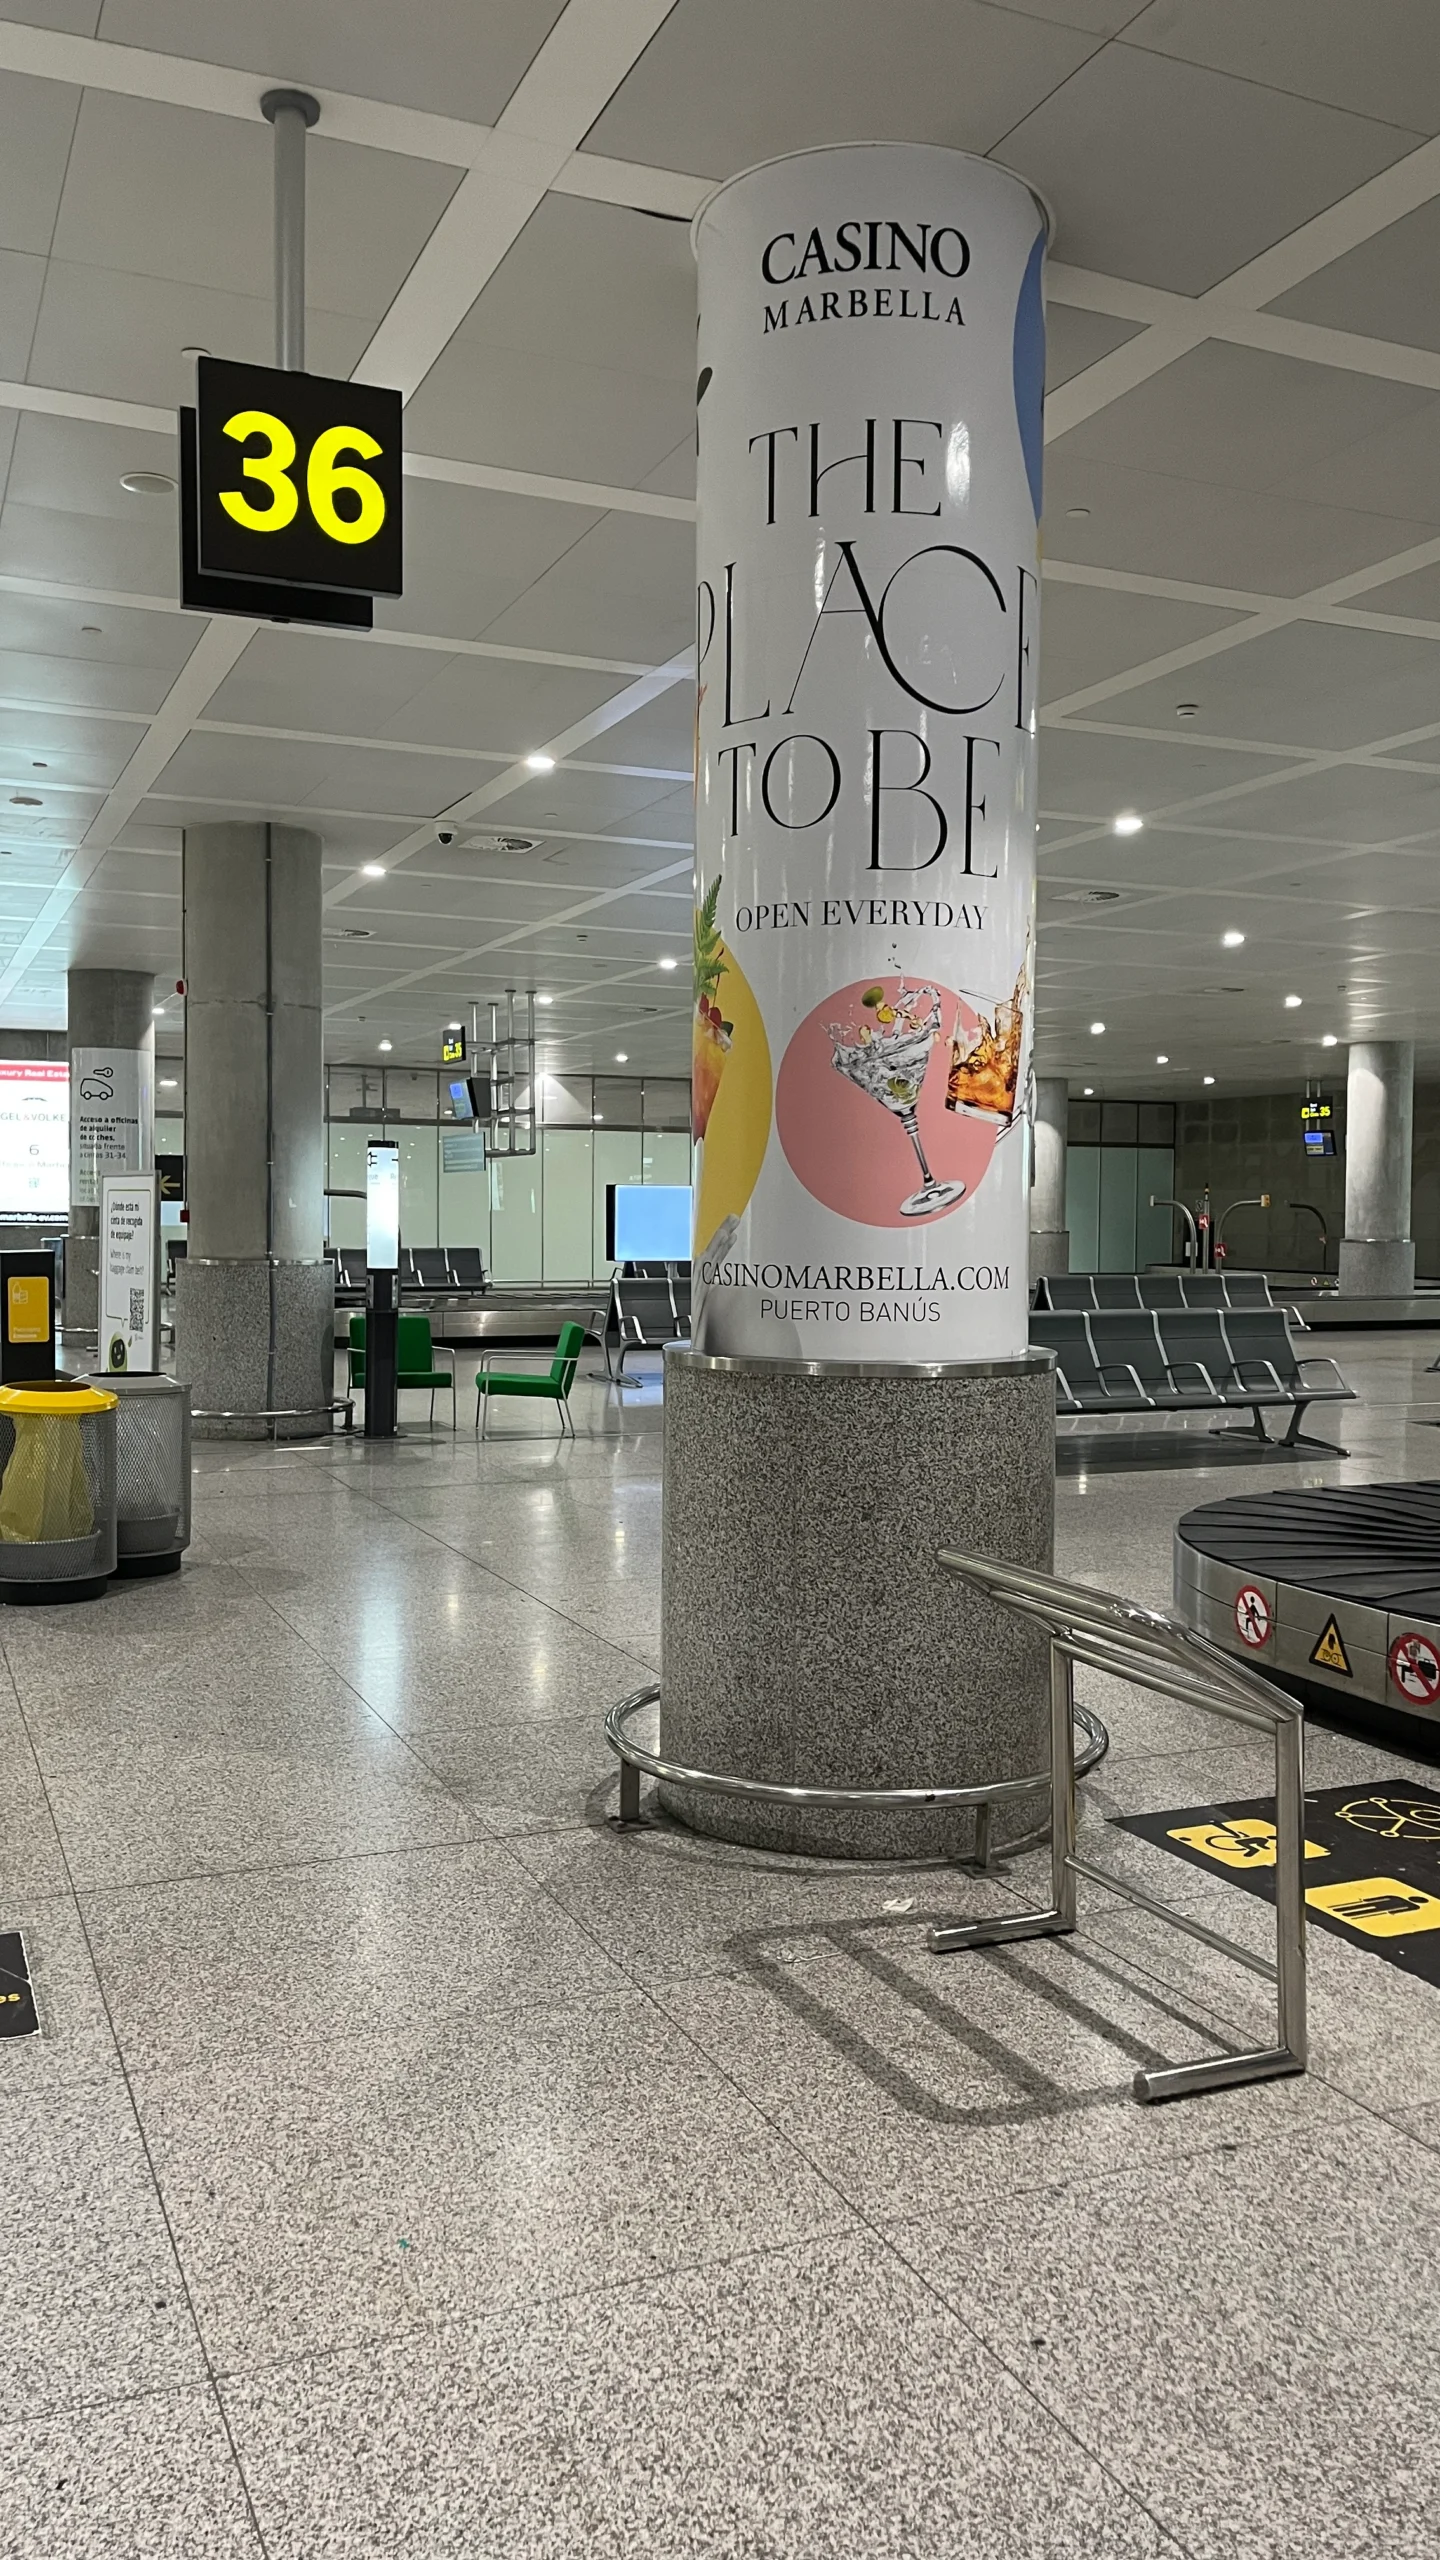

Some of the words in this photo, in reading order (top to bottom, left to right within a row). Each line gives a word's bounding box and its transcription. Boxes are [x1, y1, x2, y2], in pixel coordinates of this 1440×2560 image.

[762, 221, 971, 285] CASINO
[763, 288, 966, 334] MARBELLA
[219, 410, 385, 544] 36
[748, 418, 942, 525] THE
[718, 734, 842, 838] TO
[865, 729, 1000, 879] BE
[735, 901, 812, 932] OPEN
[820, 899, 988, 930] EVERYDAY
[29, 1144, 40, 1156] 6
[702, 1261, 1010, 1292] CASINOMARBELLA.COM
[760, 1298, 850, 1322] PUERTO
[860, 1296, 941, 1322] BANÚS
